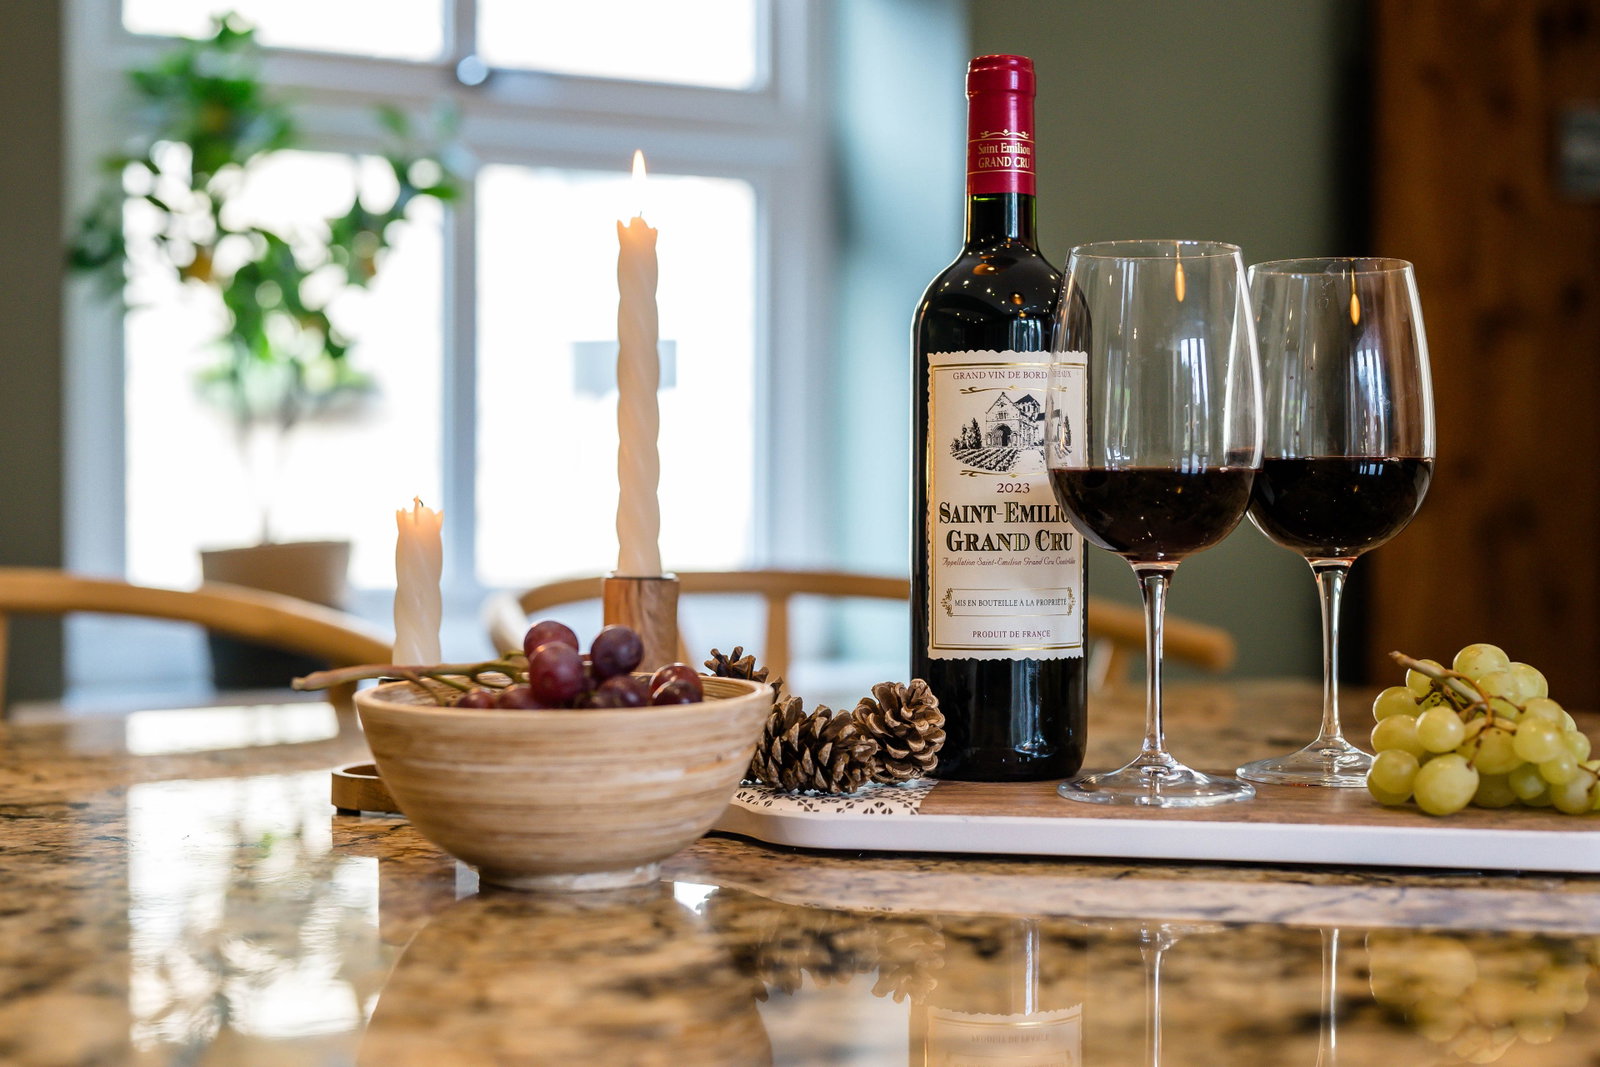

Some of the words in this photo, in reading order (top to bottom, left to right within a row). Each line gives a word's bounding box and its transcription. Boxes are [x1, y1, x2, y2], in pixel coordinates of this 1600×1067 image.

[978, 144, 998, 154] Saint
[1001, 142, 1031, 155] Emilion
[978, 156, 1012, 168] GRAND
[1014, 157, 1030, 168] CRU
[953, 371, 986, 380] GRAND
[988, 371, 1006, 379] VIN
[1008, 371, 1020, 379] DE
[996, 483, 1031, 494] 2023
[939, 501, 1068, 524] SAINT-EMILI
[946, 529, 1030, 552] GRAND
[1034, 529, 1073, 552] CRU
[942, 557, 976, 568] Appellation
[1023, 557, 1044, 566] Grand
[1044, 556, 1055, 565] Cru
[955, 599, 967, 607] MIS
[967, 599, 977, 607] EN
[978, 599, 1018, 607] BOUTEILLE
[1026, 599, 1035, 607] LA
[972, 630, 1007, 638] PRODUIT
[1009, 630, 1020, 638] DE
